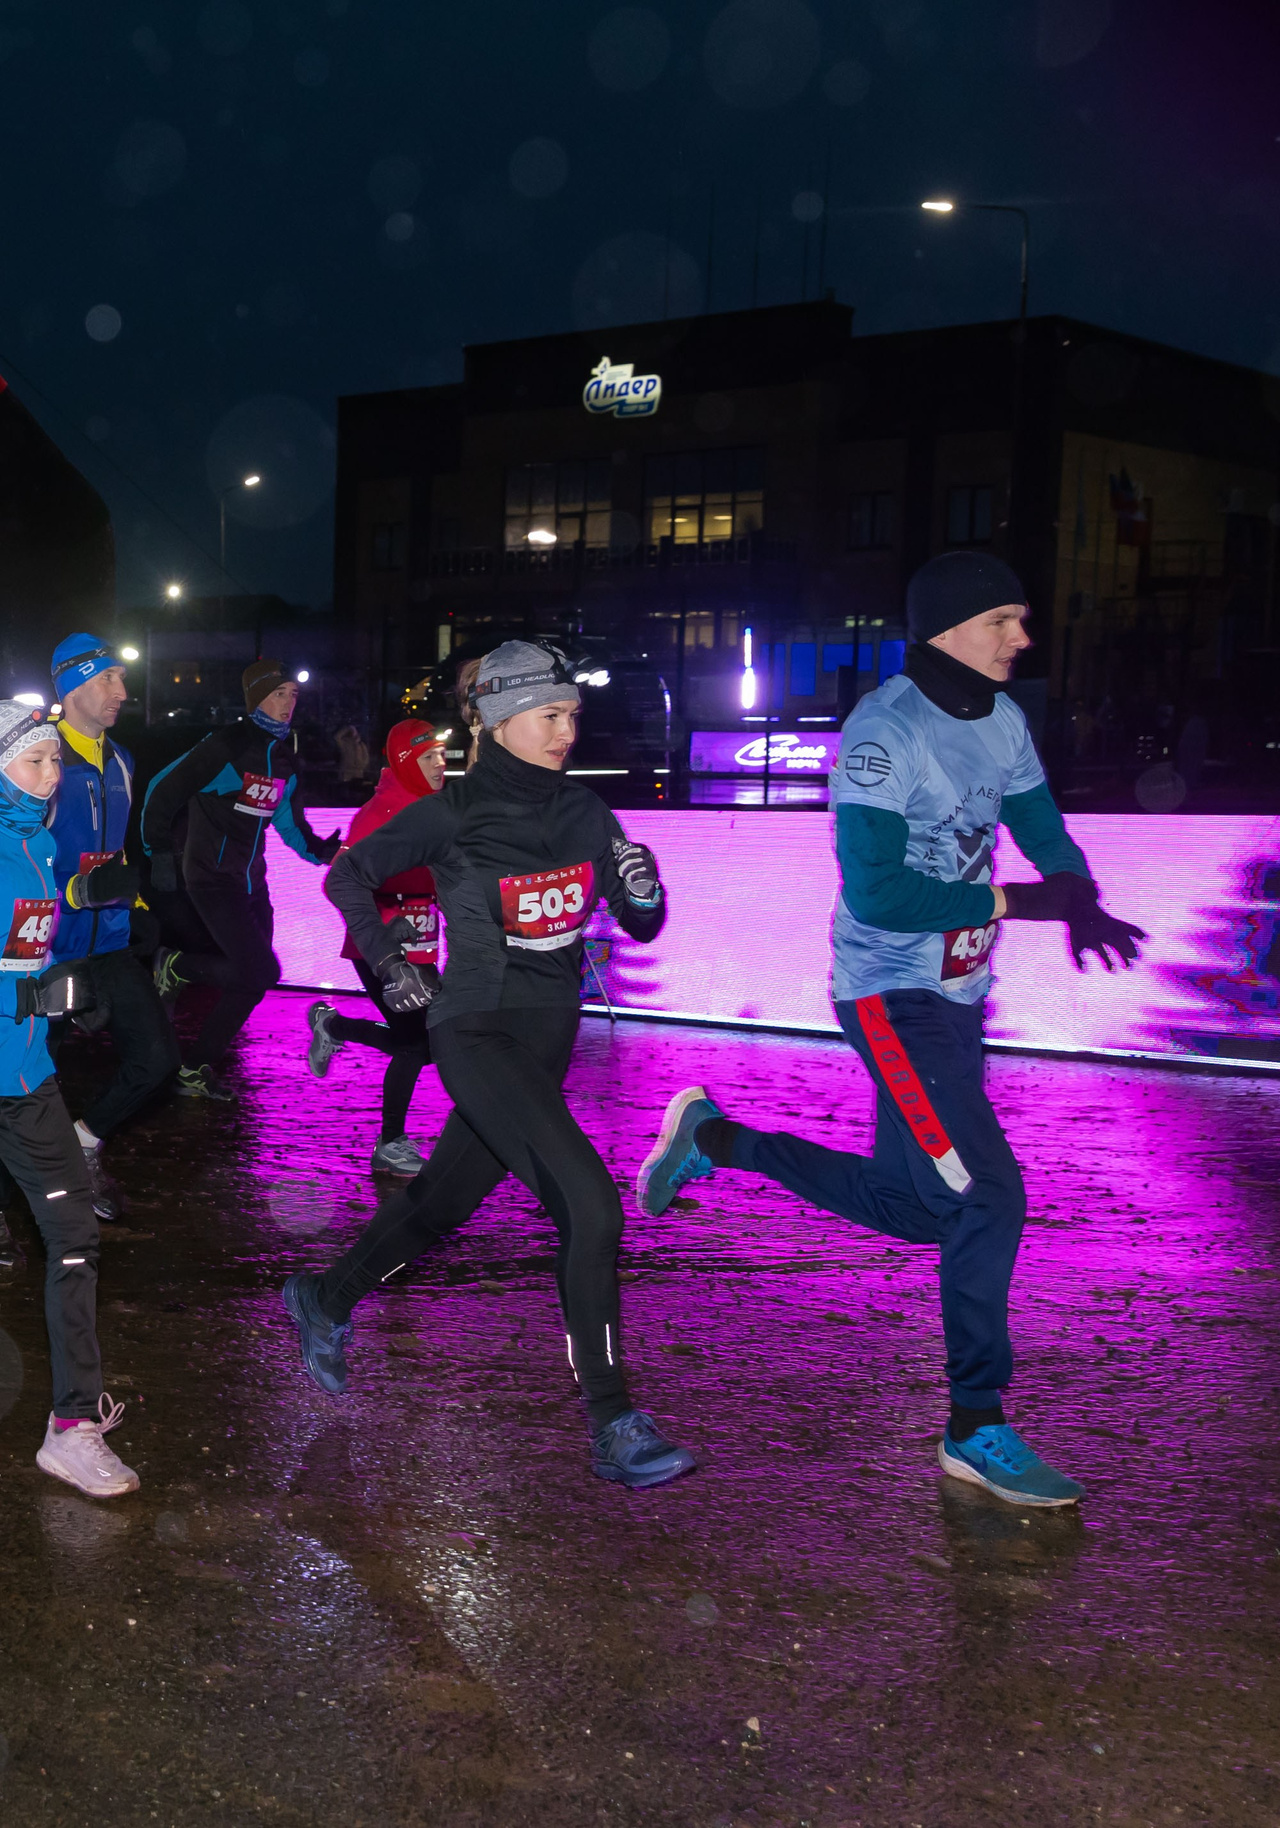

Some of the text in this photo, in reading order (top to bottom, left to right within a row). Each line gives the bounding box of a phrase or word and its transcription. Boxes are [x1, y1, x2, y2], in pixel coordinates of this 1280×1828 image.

[586, 378, 658, 402] Лидер
[507, 678, 521, 686] LED
[2, 731, 19, 747] LED
[245, 783, 278, 803] 474
[518, 882, 584, 923] 503
[547, 923, 554, 932] 3
[34, 946, 40, 955] 3
[951, 923, 996, 960] 439
